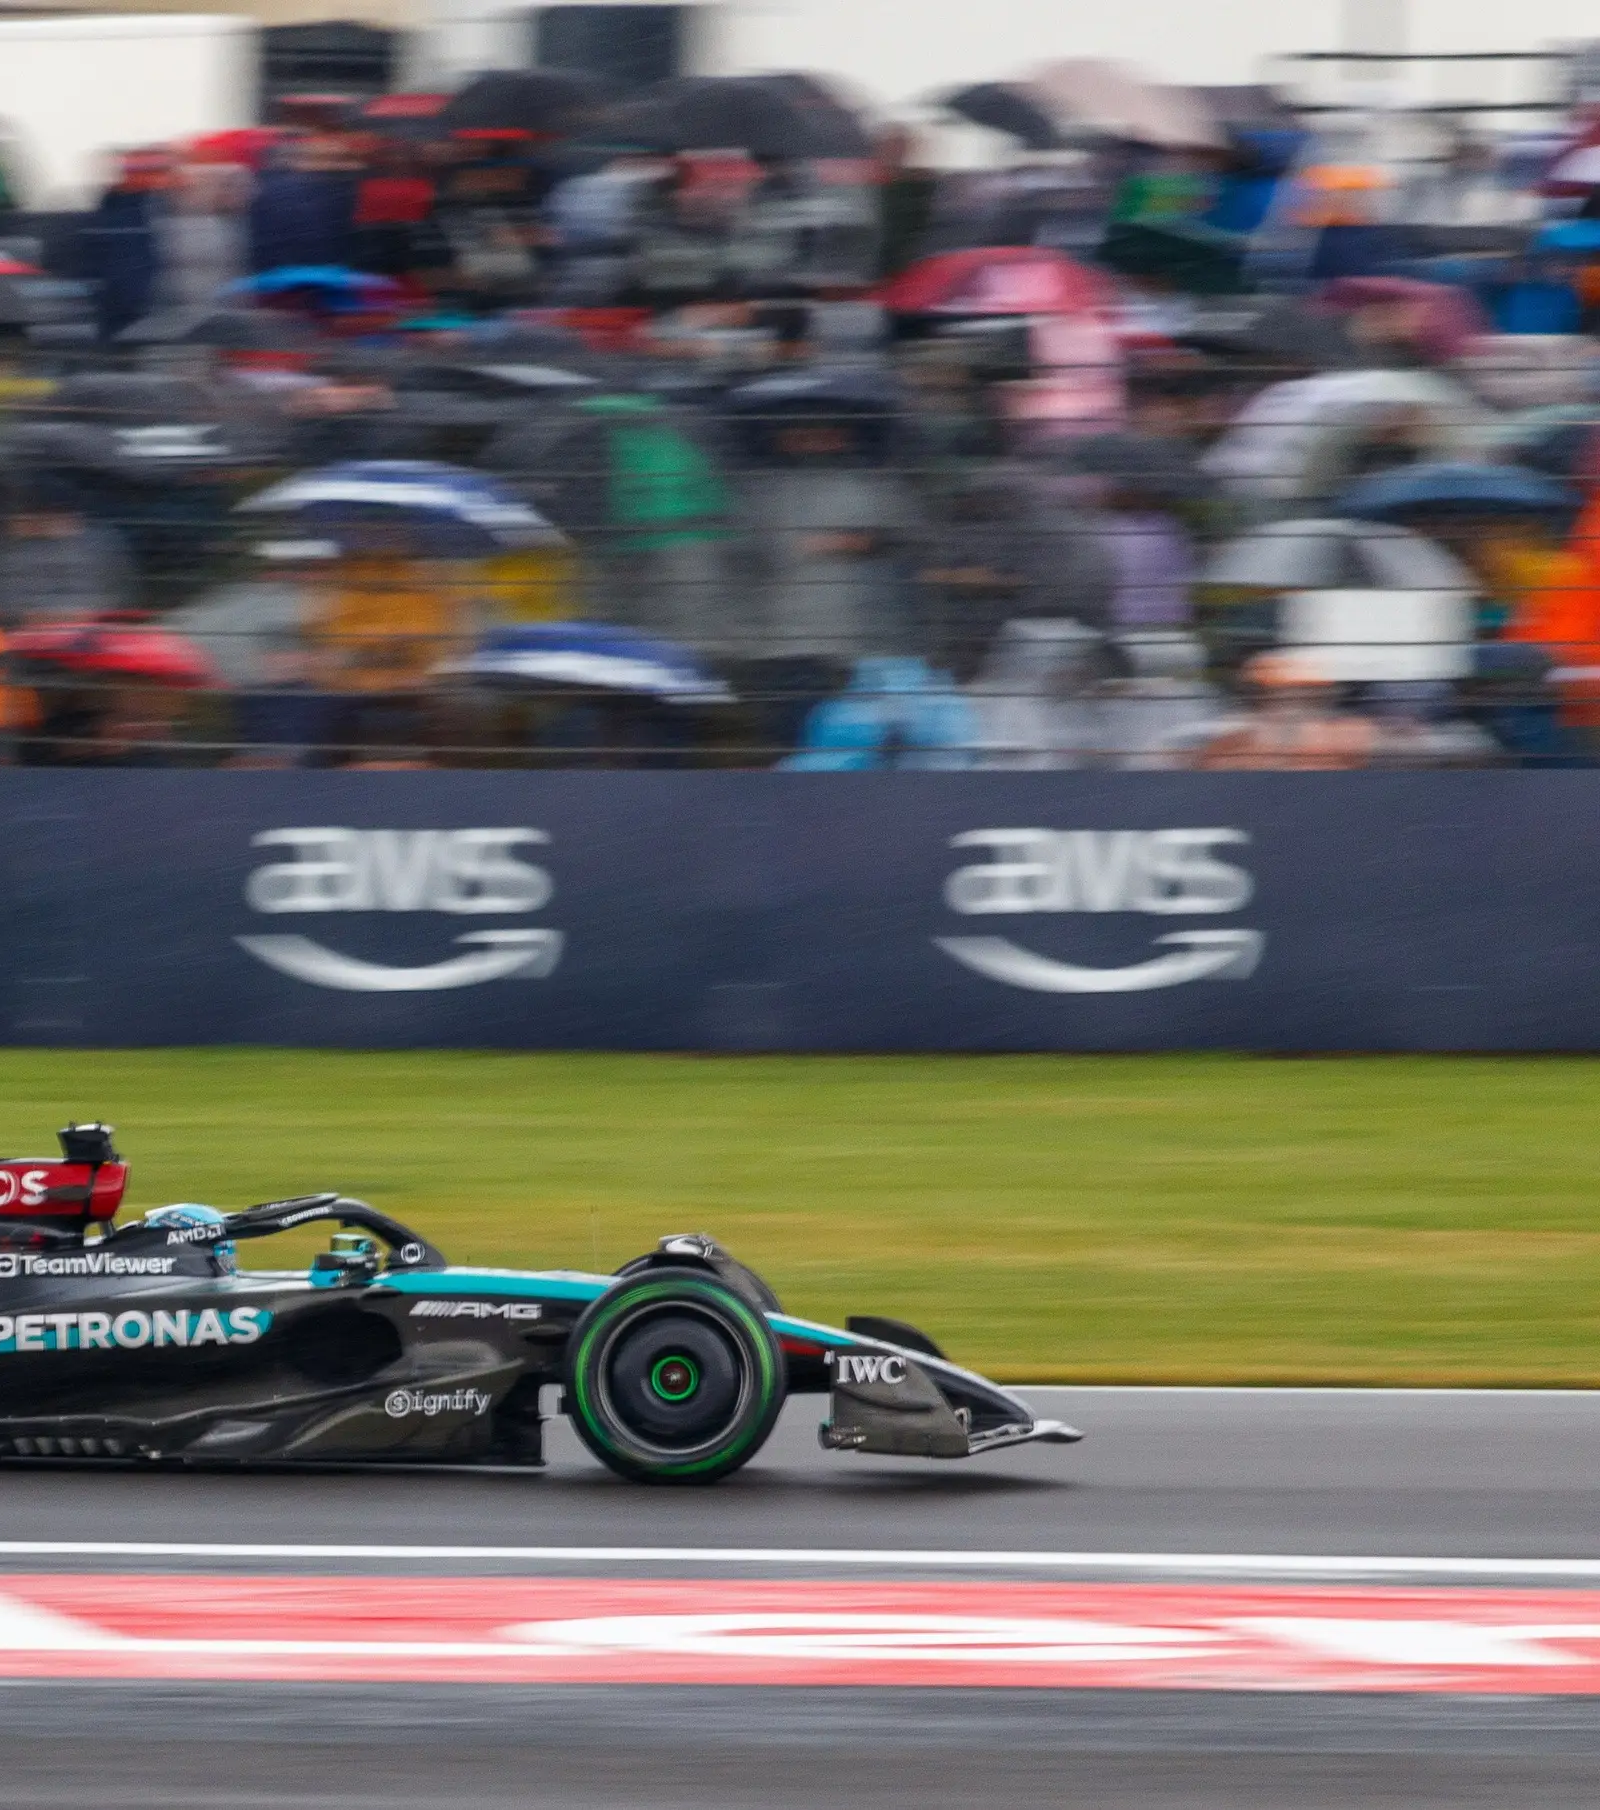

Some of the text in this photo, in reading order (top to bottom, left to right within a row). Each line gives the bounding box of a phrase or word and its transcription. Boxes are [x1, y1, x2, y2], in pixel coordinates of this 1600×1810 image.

[247, 827, 553, 914] aws
[945, 828, 1253, 915] aws
[167, 1227, 206, 1245] AMD
[18, 1252, 177, 1275] TeamViewer
[453, 1302, 542, 1319] AMG
[837, 1355, 907, 1384] IWC
